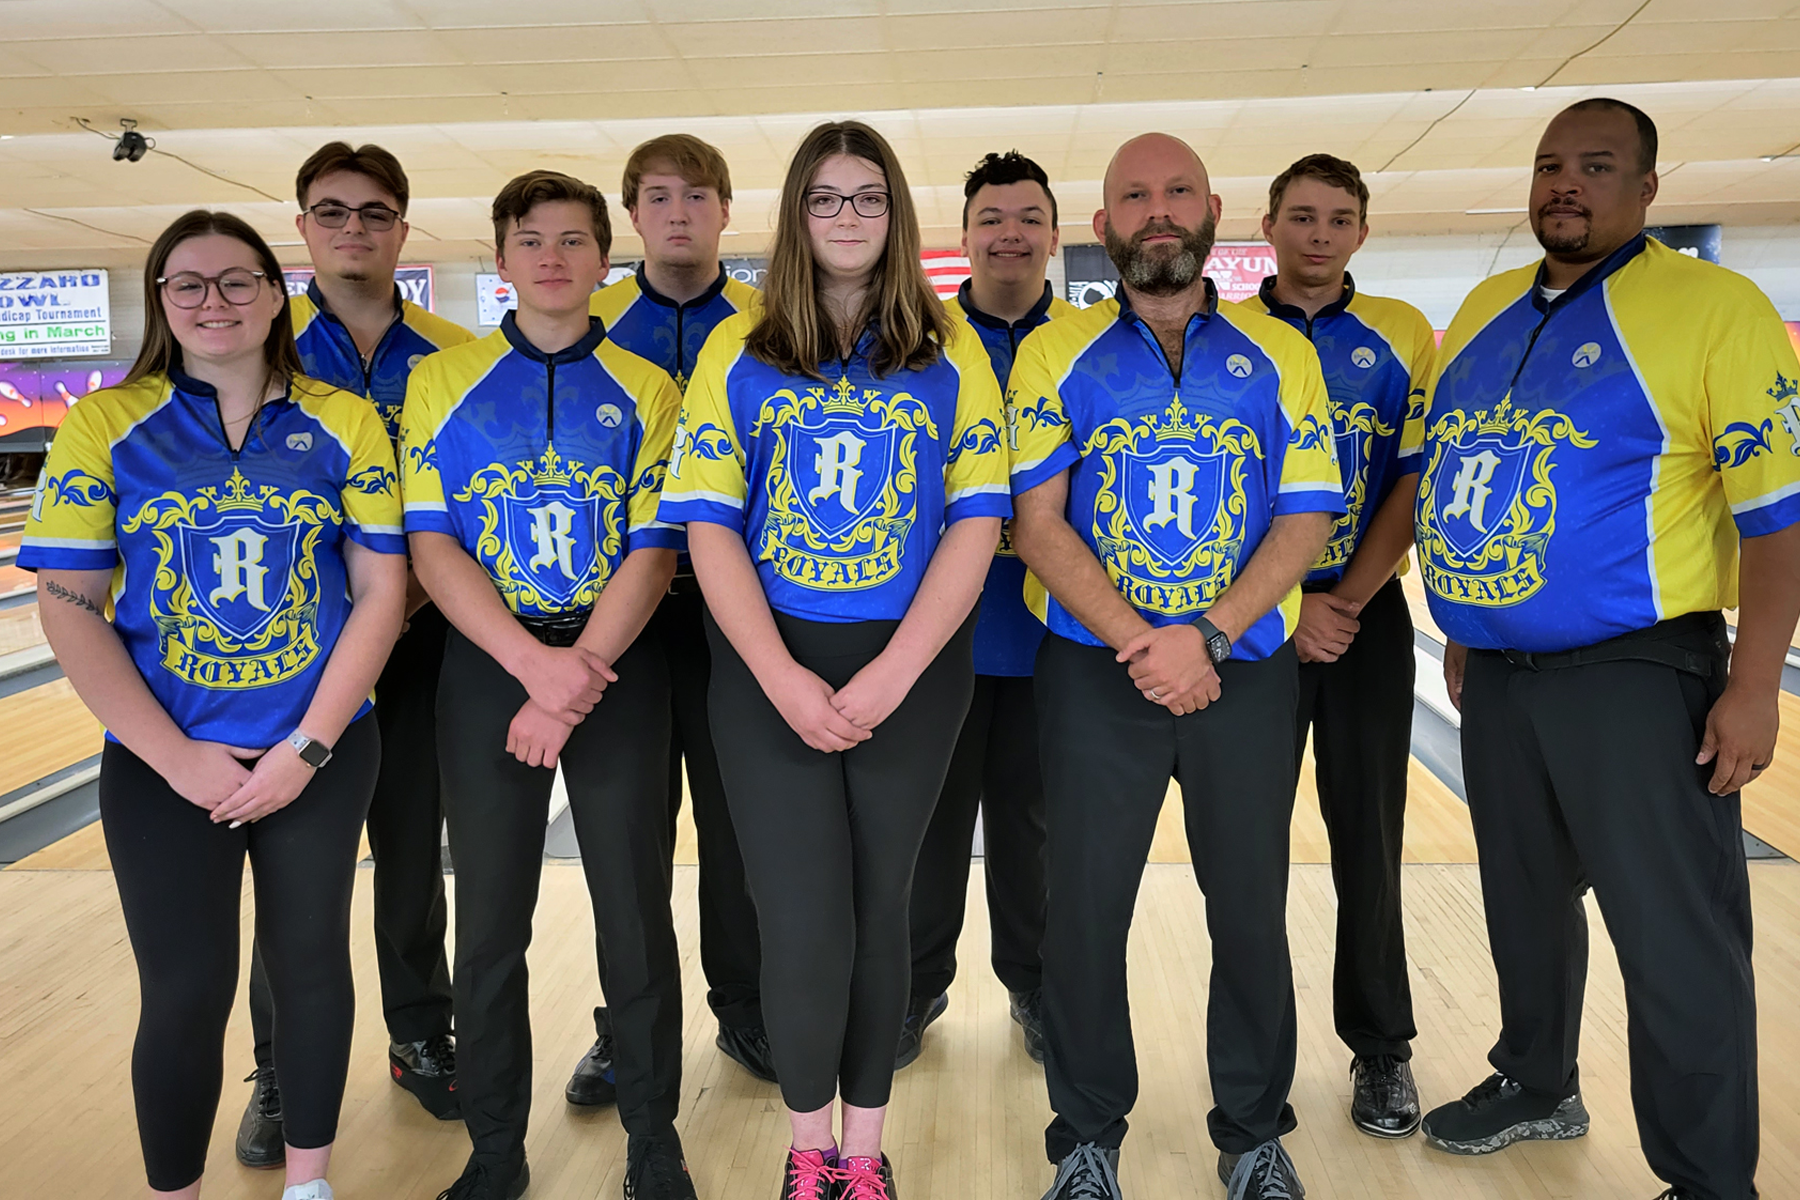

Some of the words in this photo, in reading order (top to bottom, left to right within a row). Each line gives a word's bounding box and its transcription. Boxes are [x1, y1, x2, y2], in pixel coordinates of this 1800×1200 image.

[1, 310, 31, 323] dicap
[36, 306, 102, 320] Tournament
[24, 327, 39, 339] in
[47, 325, 105, 338] March
[19, 346, 28, 355] for
[31, 346, 47, 354] more
[50, 344, 89, 353] information
[808, 430, 867, 515] R
[1442, 449, 1502, 534] R
[1143, 456, 1200, 540] R
[526, 500, 579, 581] R
[209, 526, 272, 612] R
[772, 546, 895, 586] ROYALS
[1423, 566, 1539, 602] ROYALS
[1116, 571, 1228, 611] ROYALS
[176, 639, 314, 686] ROYALS
